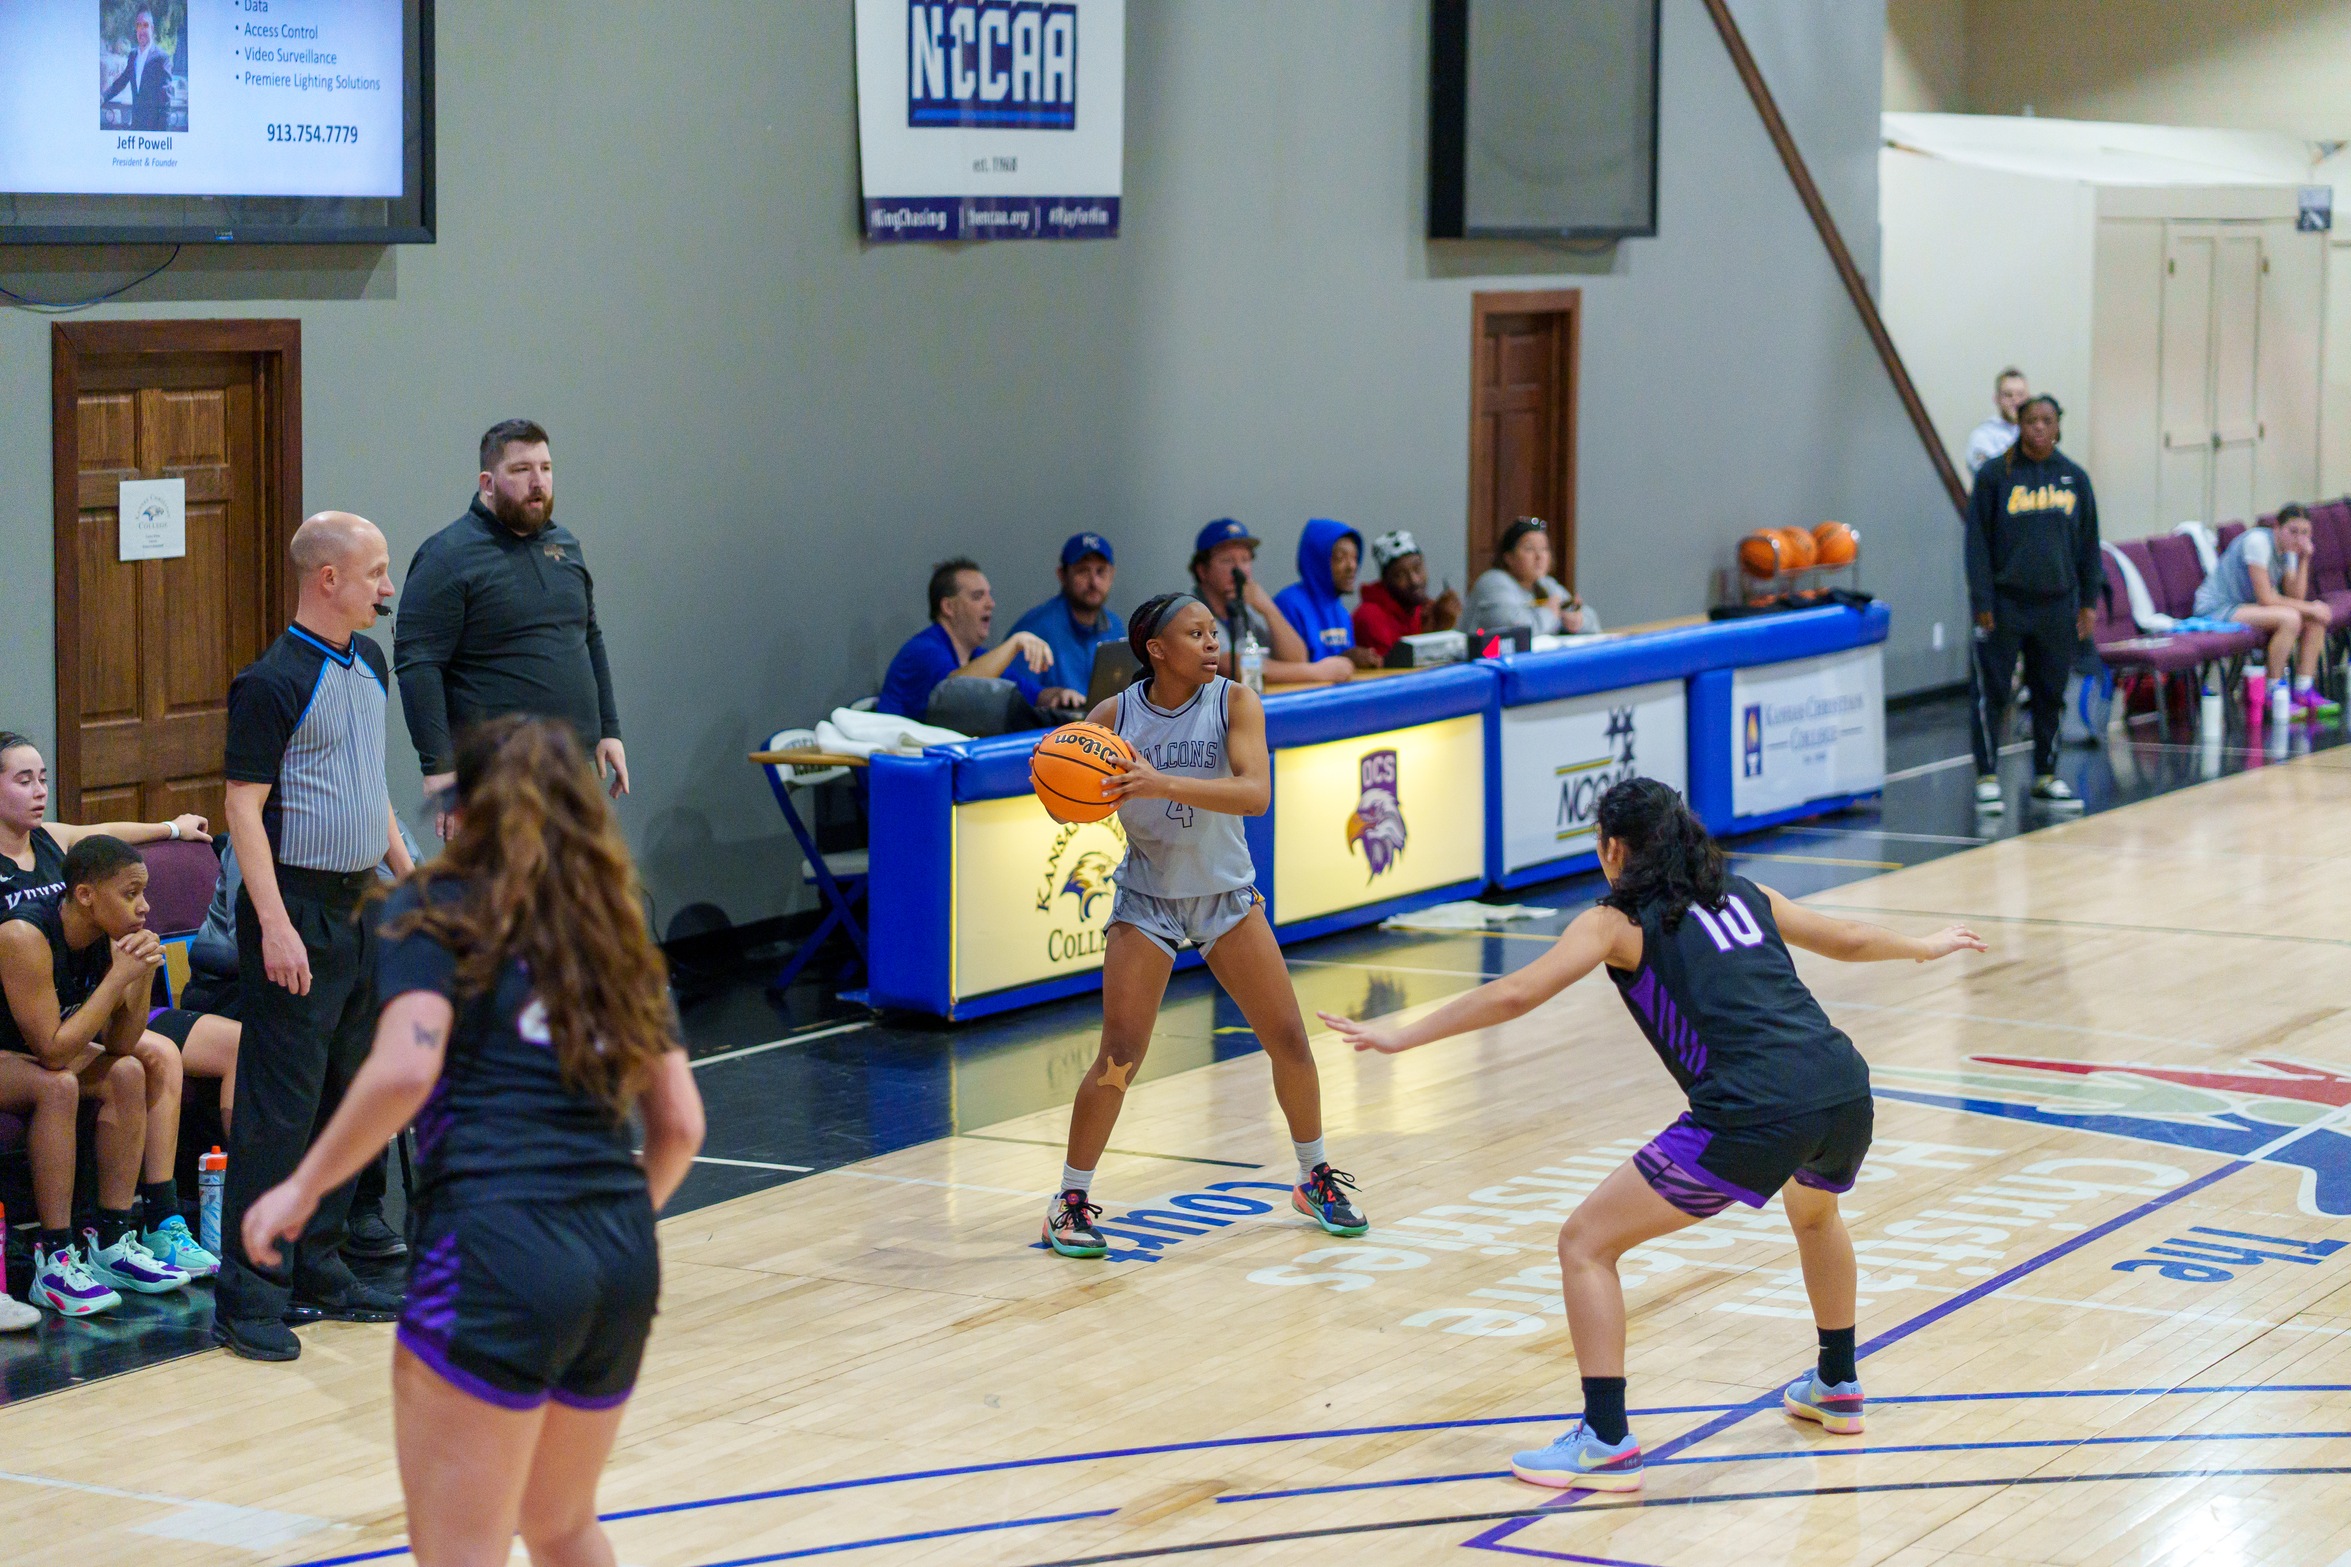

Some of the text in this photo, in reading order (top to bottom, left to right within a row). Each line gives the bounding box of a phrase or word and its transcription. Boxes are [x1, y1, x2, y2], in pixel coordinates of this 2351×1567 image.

[243, 0, 268, 12] Data
[244, 22, 318, 39] Access Control
[244, 46, 337, 64] Video Surveillance
[911, 4, 1074, 103] NCCAA
[245, 71, 381, 92] Premiere Lighting Solutions
[116, 136, 173, 151] Jeff Powell
[267, 123, 358, 143] 913.754.7779
[112, 157, 178, 168] President & Founder
[1053, 733, 1119, 770] Wilson
[1139, 740, 1218, 770] ALCONS
[1166, 801, 1194, 828] 4
[1686, 894, 1764, 952] 10
[1048, 928, 1107, 962] COLLE
[2111, 1226, 2349, 1284] The
